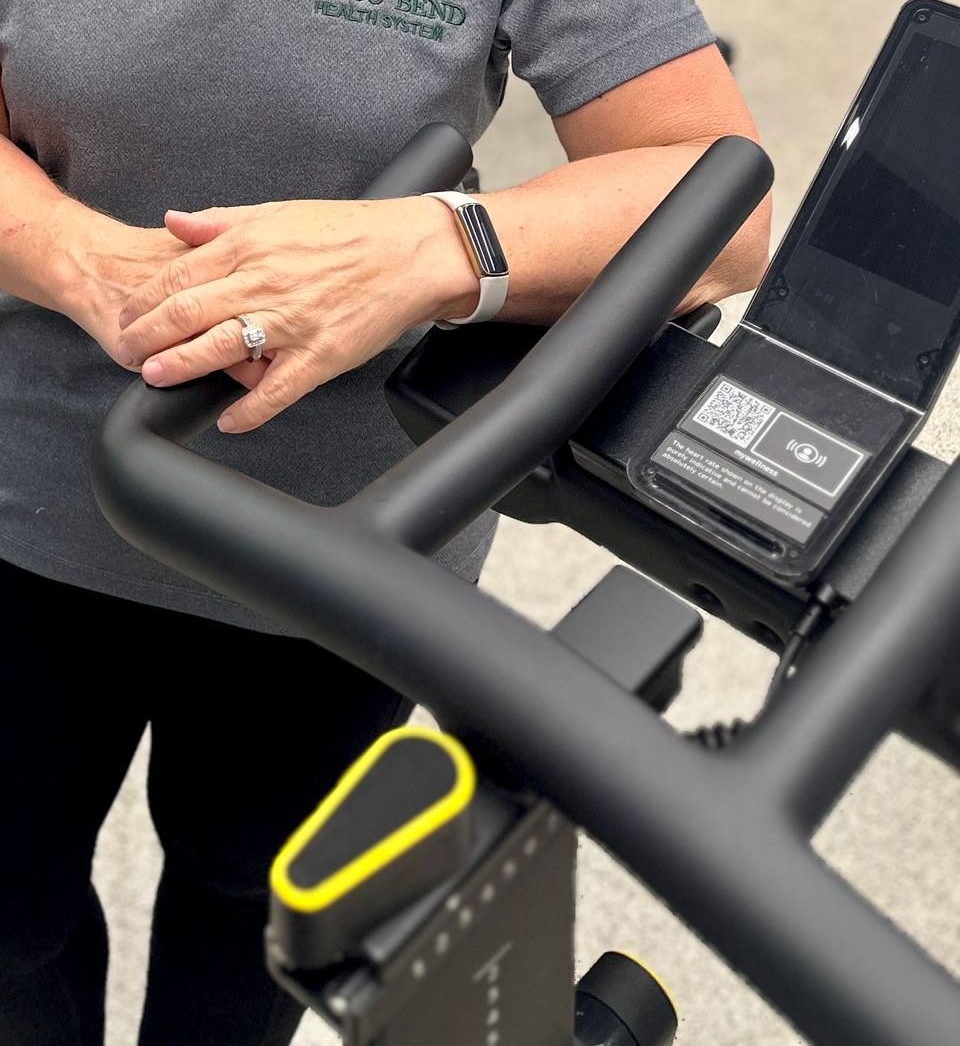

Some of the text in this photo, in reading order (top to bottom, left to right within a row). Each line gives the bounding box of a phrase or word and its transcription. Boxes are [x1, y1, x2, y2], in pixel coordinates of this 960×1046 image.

[313, 0, 446, 42] HEALTH SYSTEM
[661, 453, 724, 490] absolutely certain.
[673, 439, 803, 515] The heart rate shown on the display is
[734, 449, 779, 477] mywellness
[665, 446, 813, 529] purely indicative and cannot be considered
